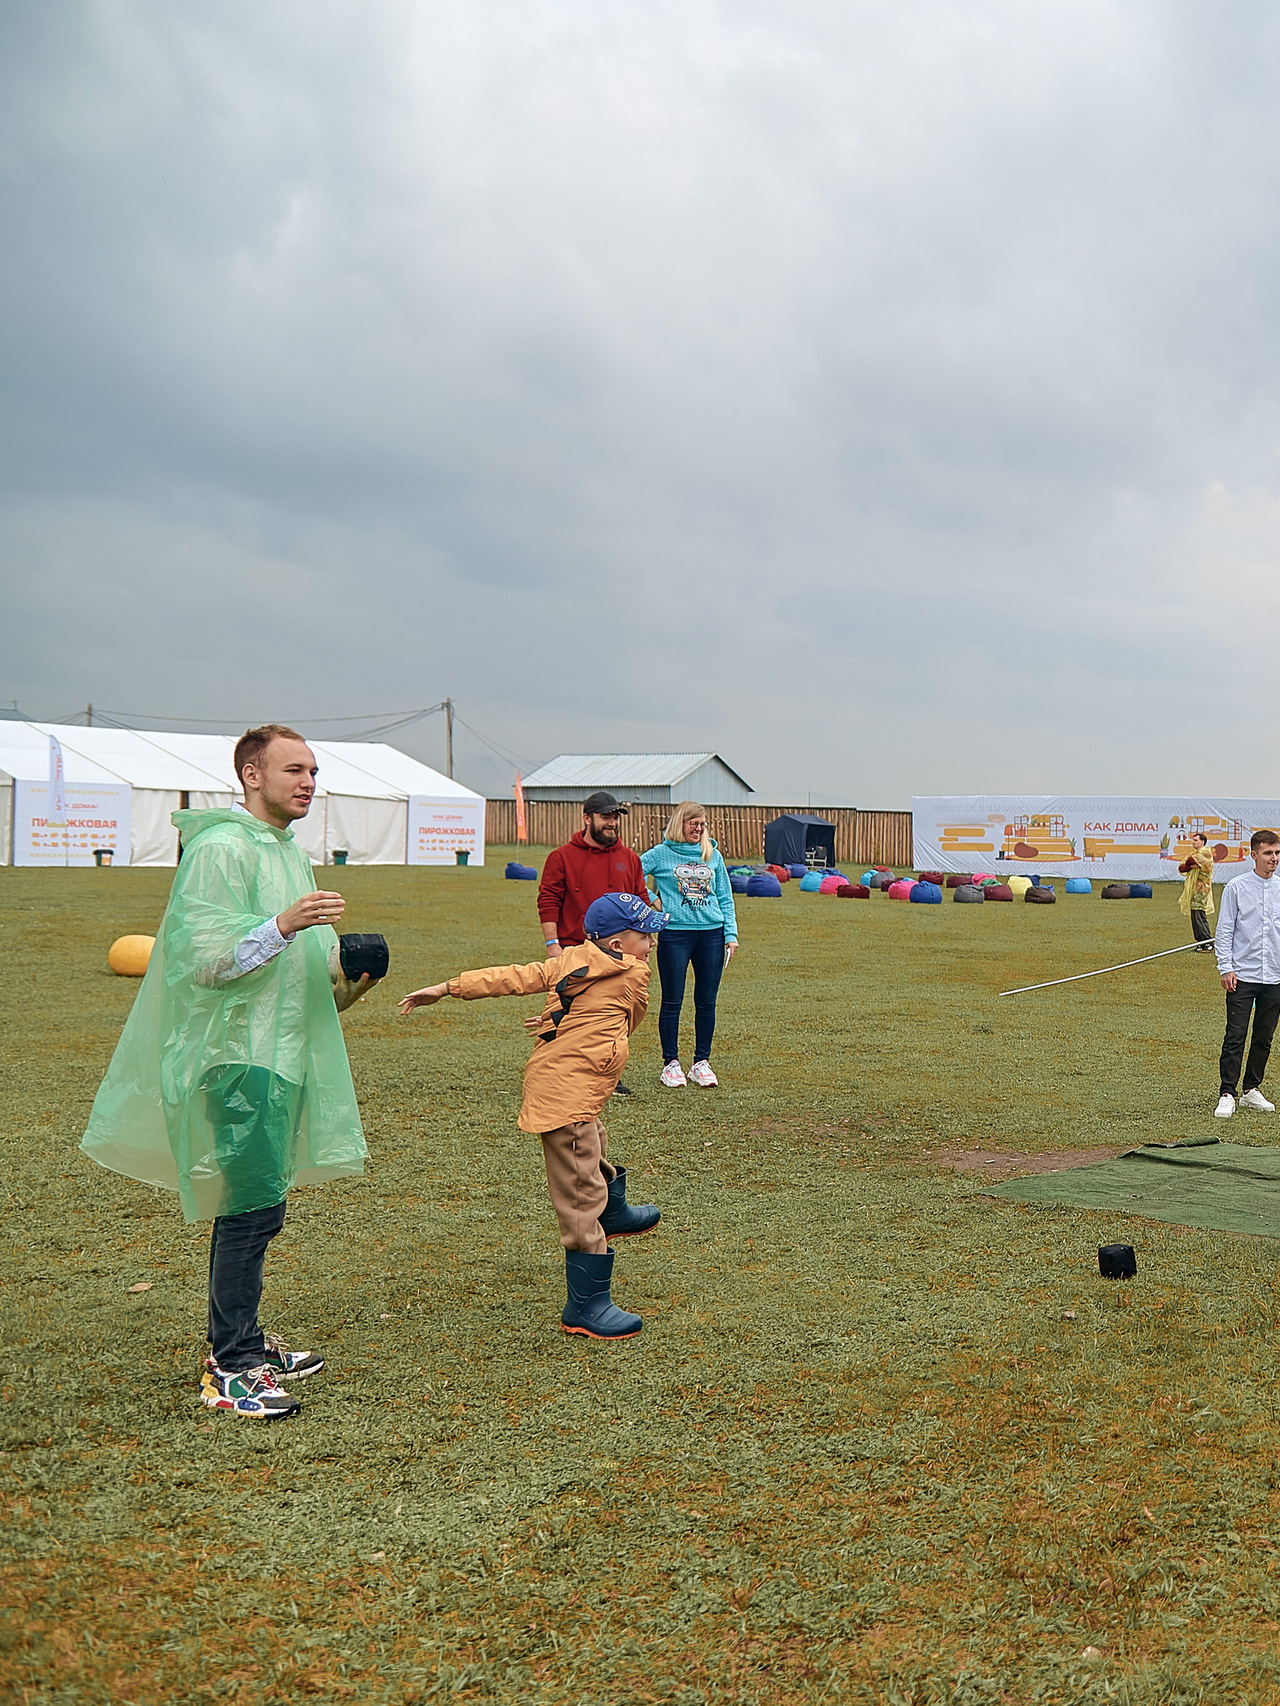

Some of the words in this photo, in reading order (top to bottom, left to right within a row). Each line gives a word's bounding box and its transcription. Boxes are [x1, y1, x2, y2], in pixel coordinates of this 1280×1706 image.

[31, 818, 117, 828] ПИЖКОВАЯ
[1084, 822, 1111, 830] КАК
[1115, 822, 1159, 833] ДОМА!
[419, 827, 475, 835] ПИРОЖКОВАЯ
